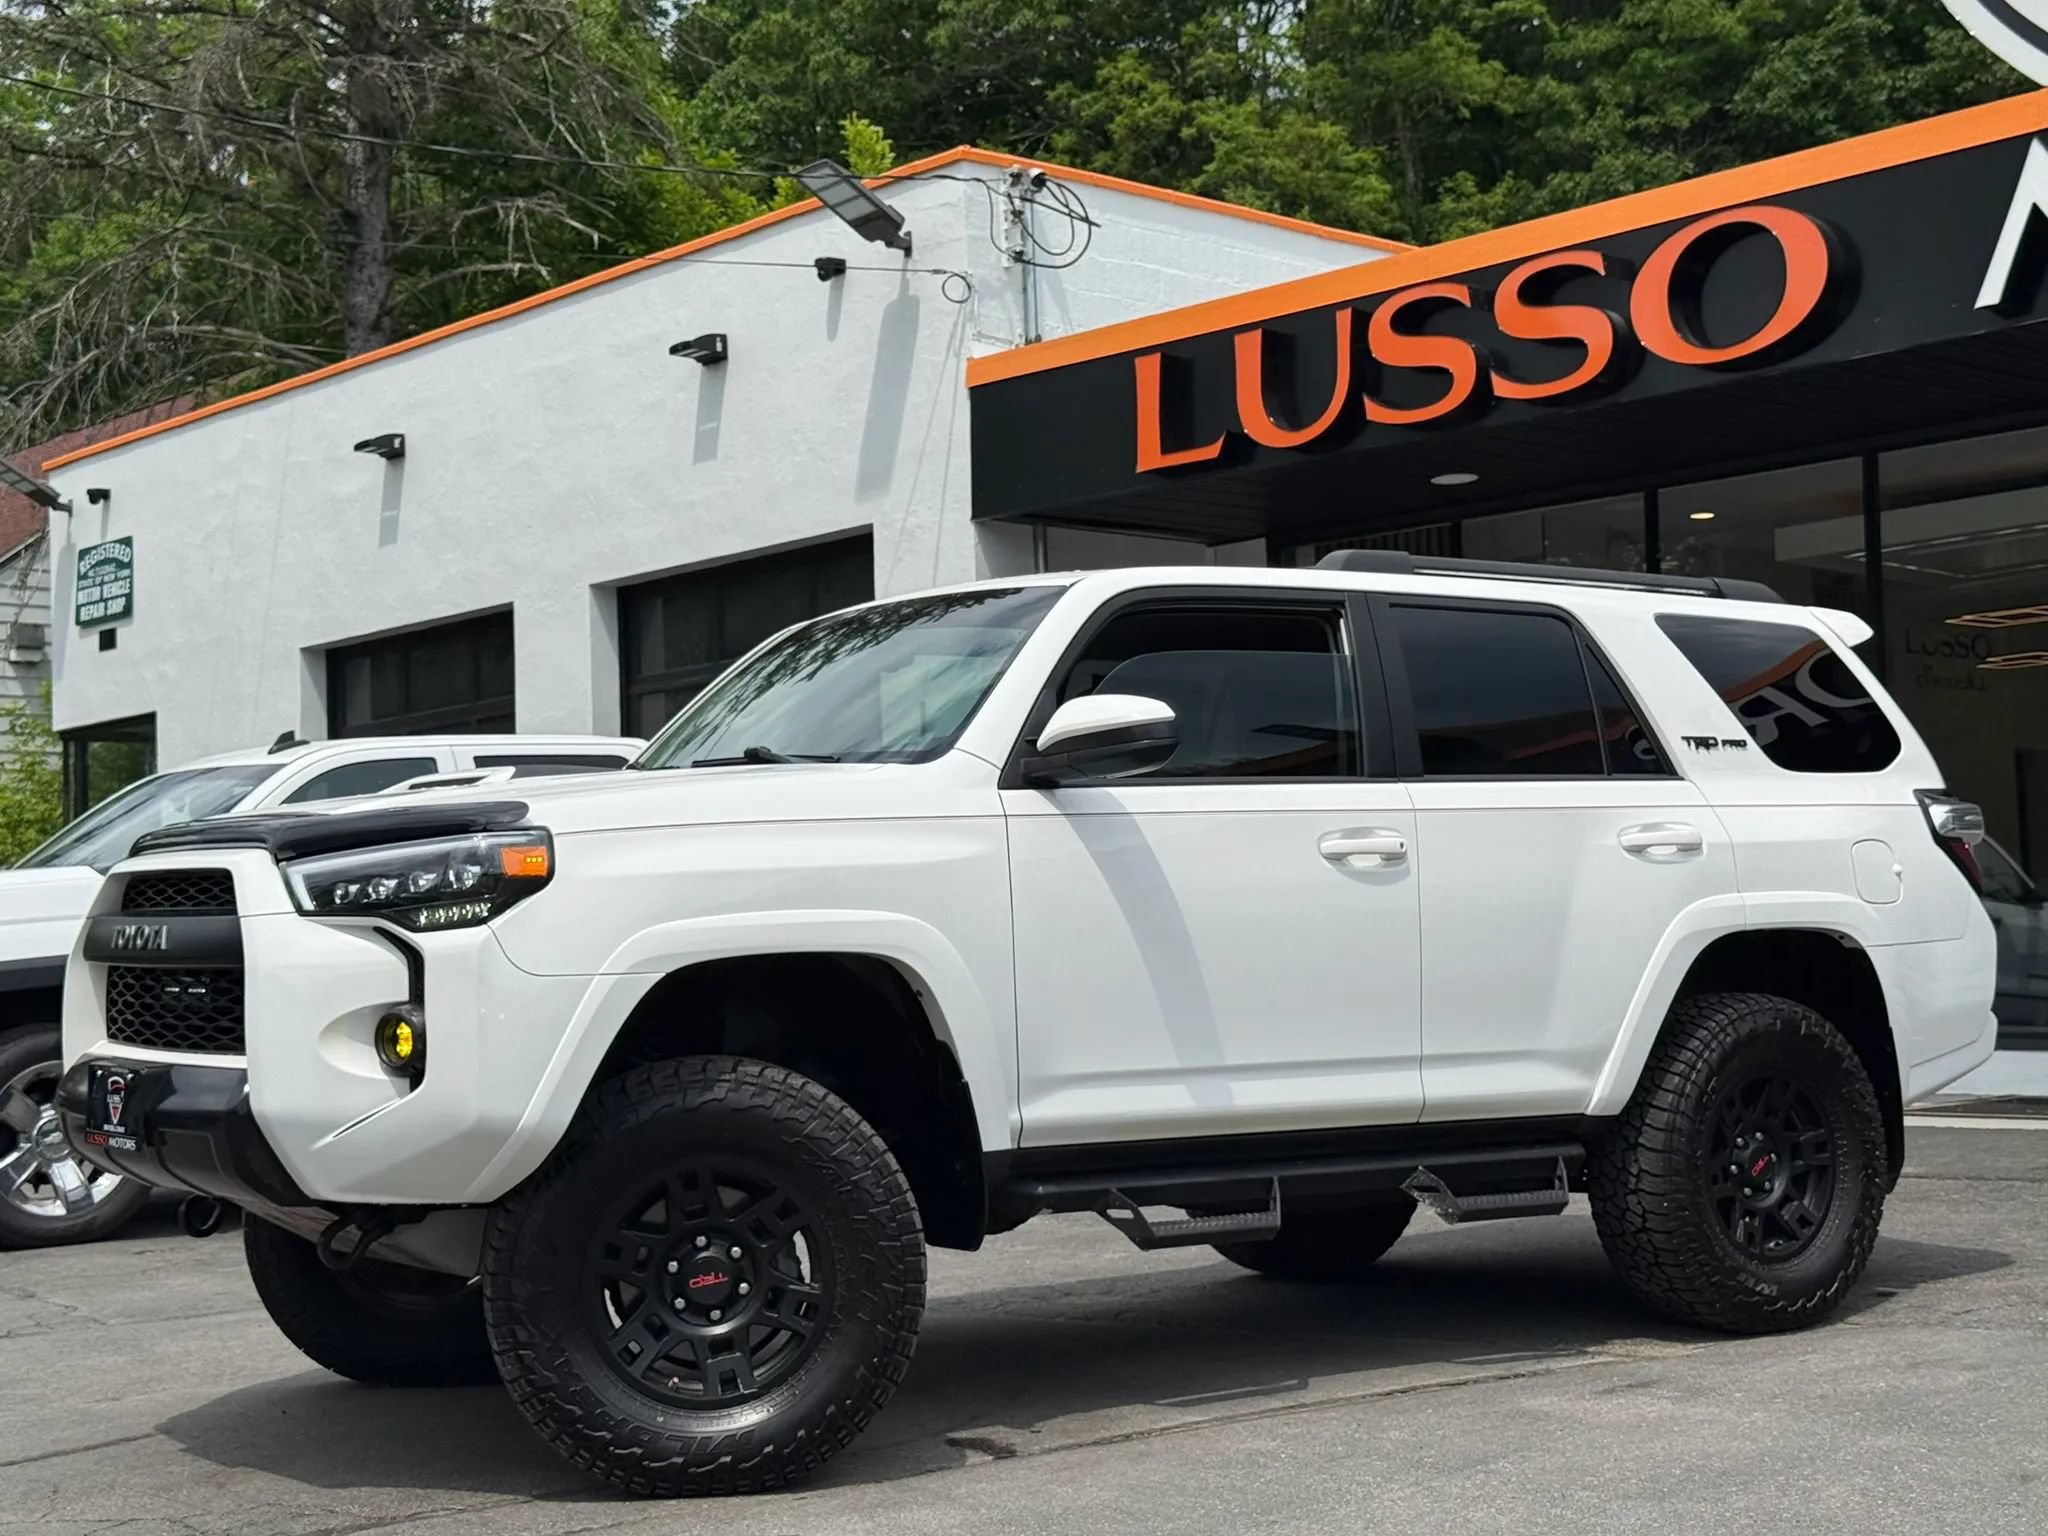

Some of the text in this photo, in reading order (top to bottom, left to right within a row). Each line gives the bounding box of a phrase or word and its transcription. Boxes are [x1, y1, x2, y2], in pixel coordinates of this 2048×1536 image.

[1134, 205, 1830, 472] LUSSO
[79, 542, 132, 576] REGISTERED
[77, 578, 131, 606] MOTOR VEHICLE
[79, 596, 126, 622] REPAIR SHOP
[1681, 735, 1748, 751] TRD PRO
[111, 924, 168, 950] TOYOTA
[108, 1137, 137, 1150] MOTORS
[689, 1271, 729, 1289] TRD
